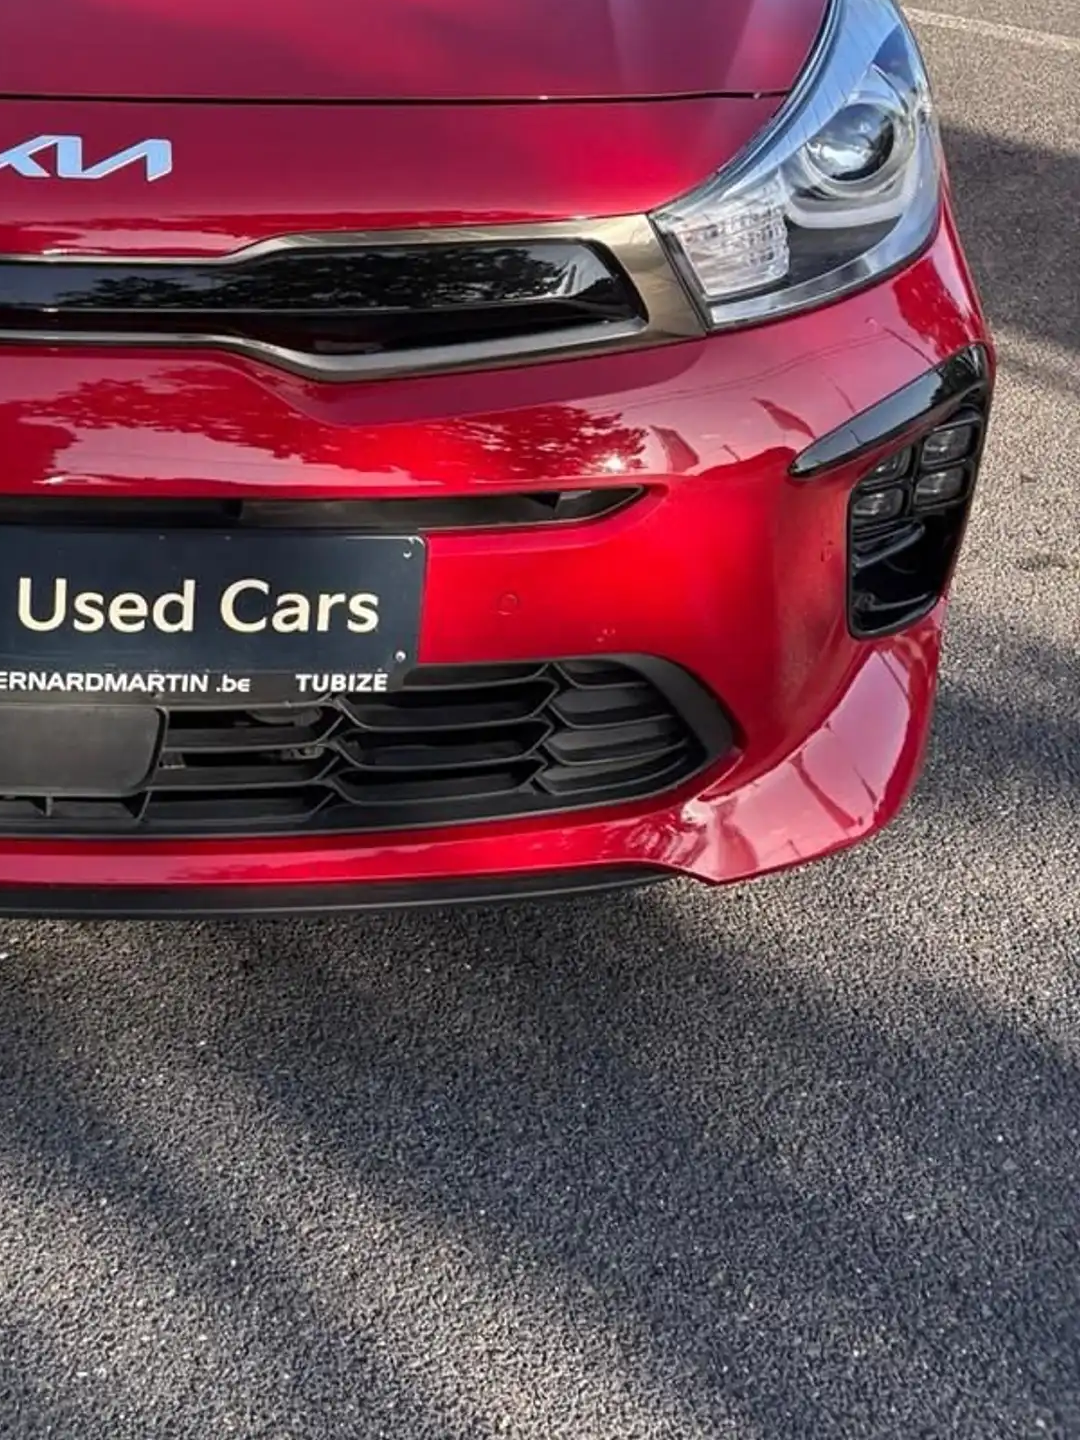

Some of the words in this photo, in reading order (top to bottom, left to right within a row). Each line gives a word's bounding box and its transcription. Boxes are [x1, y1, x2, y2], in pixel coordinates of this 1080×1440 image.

[18, 577, 196, 633] Used
[220, 578, 379, 633] Cars
[295, 672, 388, 693] TUBIZE
